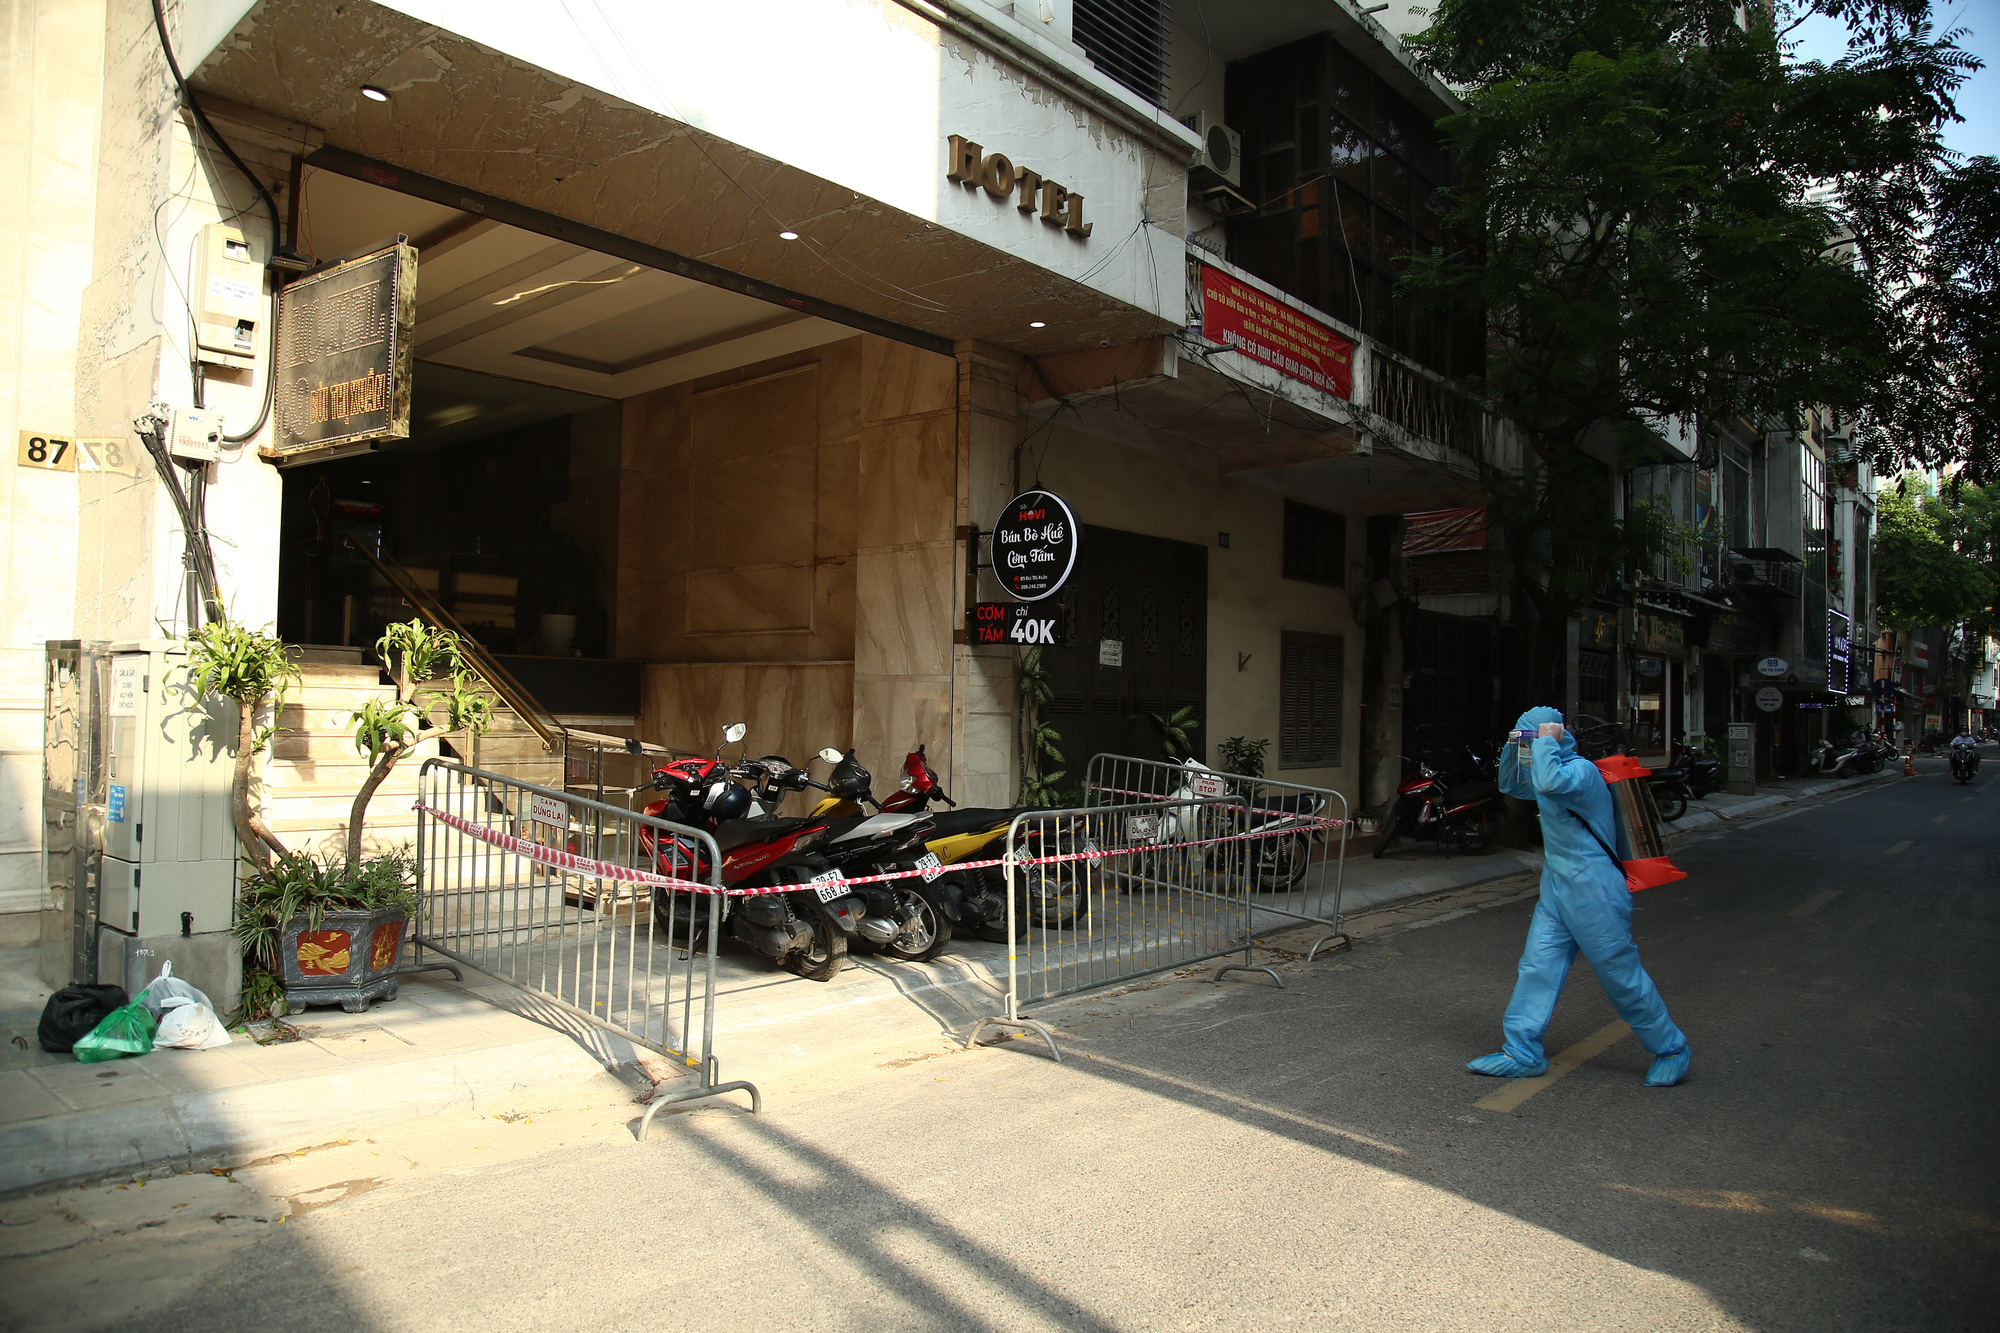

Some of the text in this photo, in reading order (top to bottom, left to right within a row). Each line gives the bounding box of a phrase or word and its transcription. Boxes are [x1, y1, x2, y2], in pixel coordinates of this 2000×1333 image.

[947, 134, 1093, 238] HOTEL
[1206, 288, 1218, 301] CHỦ
[284, 279, 386, 370] HOTEL
[1222, 328, 1246, 350] KHÔNG
[1247, 339, 1256, 355] CÓ
[1257, 344, 1271, 361] NHU
[1271, 349, 1284, 367] CẦU
[1285, 355, 1299, 374] GIAO
[1299, 364, 1313, 380] DỊCH
[310, 381, 329, 425] BÙI
[330, 381, 349, 425] THỊ
[349, 367, 386, 417] XUÂN
[27, 436, 69, 464] 87
[178, 438, 209, 450] 19001515
[1000, 522, 1064, 544] Bún Bò Huế
[1007, 544, 1055, 569] Cơm Tấm
[977, 604, 1005, 620] CƠM
[1015, 605, 1029, 617] chỉ
[978, 623, 1004, 642] TẤM
[1010, 618, 1056, 644] 40K
[1767, 659, 1778, 667] 99
[1199, 785, 1217, 793] STOP
[533, 804, 564, 823] DỪNG LẠI
[176, 1022, 200, 1037] PIZZA
